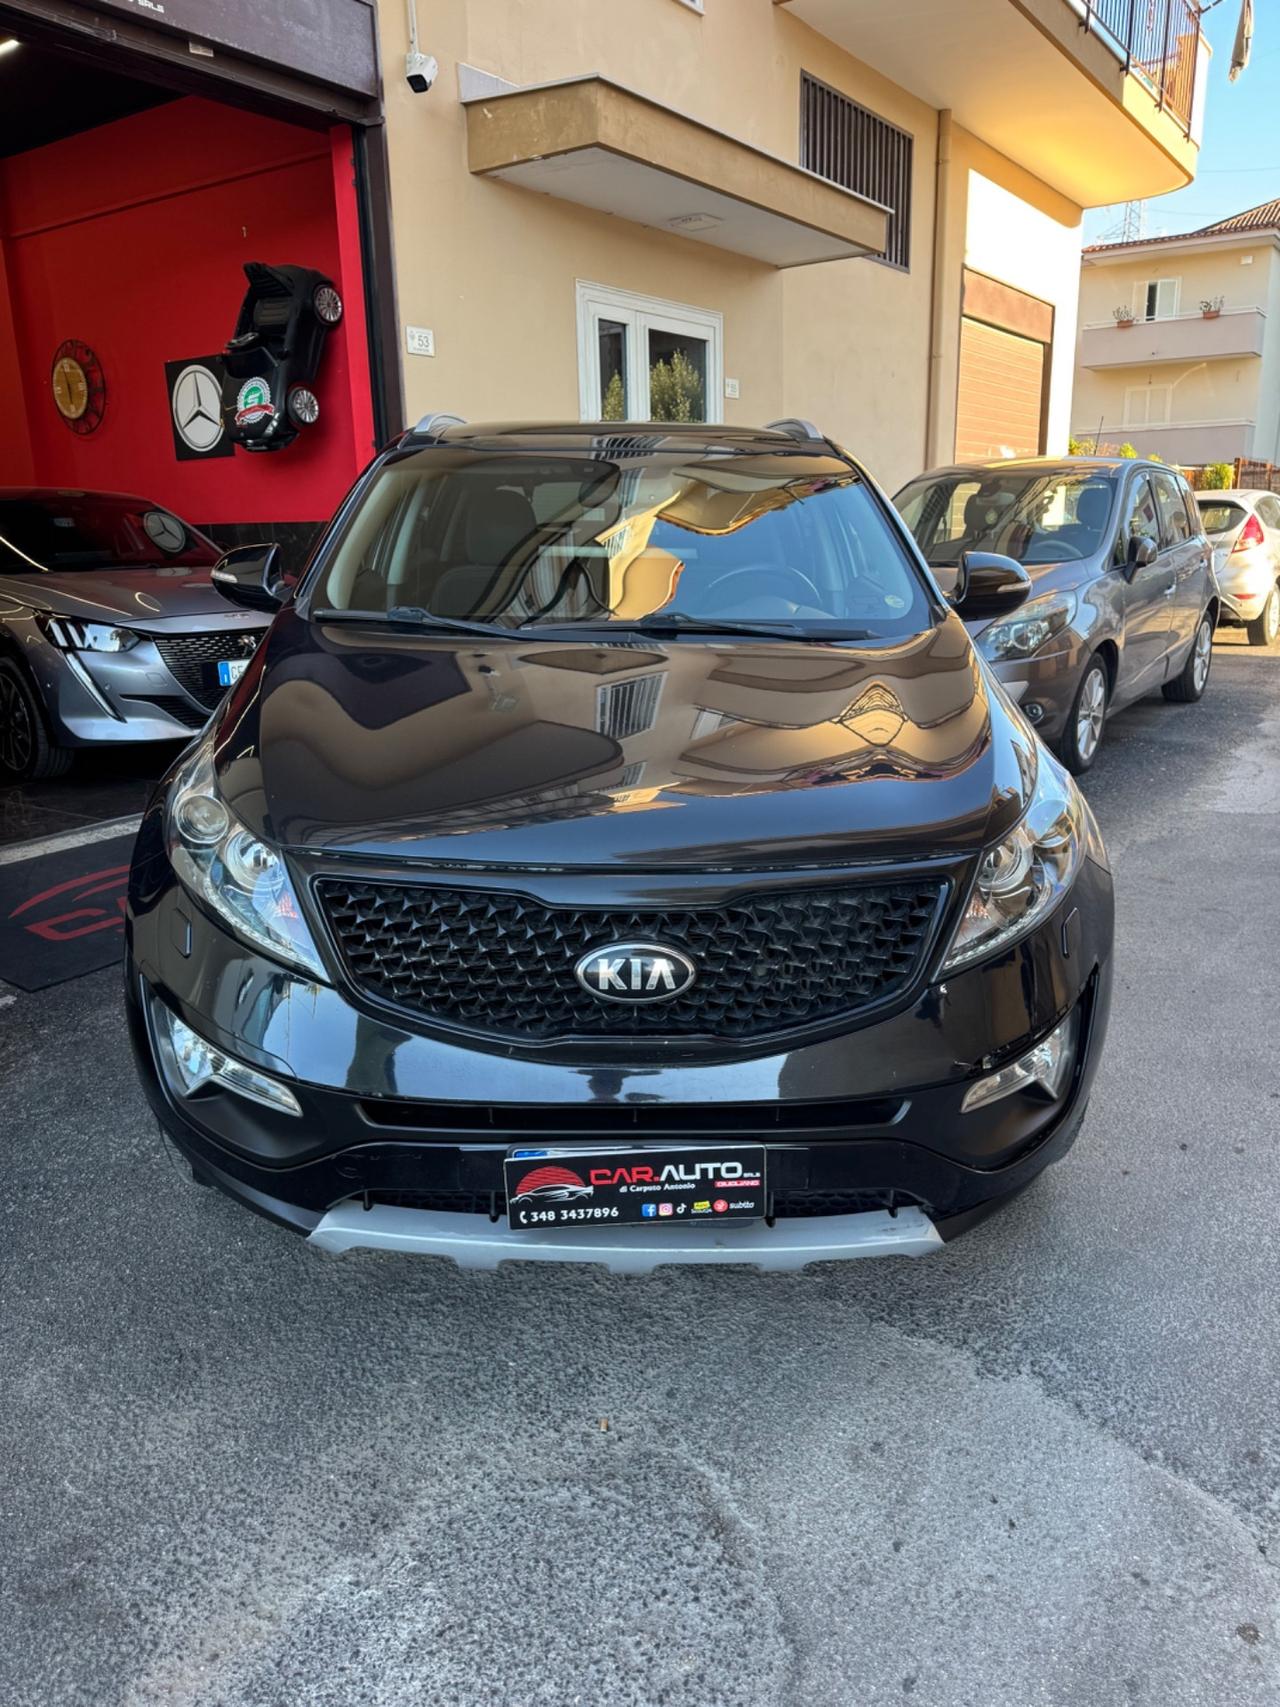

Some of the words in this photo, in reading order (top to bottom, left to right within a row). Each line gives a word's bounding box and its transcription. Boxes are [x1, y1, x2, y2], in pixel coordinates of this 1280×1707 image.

[417, 335, 430, 348] 53
[598, 958, 676, 990] KIA
[619, 1185, 628, 1193] di
[663, 1182, 696, 1191] Antonio
[729, 1200, 755, 1209] subito
[530, 1210, 556, 1222] 348
[560, 1206, 619, 1220] 3437896
